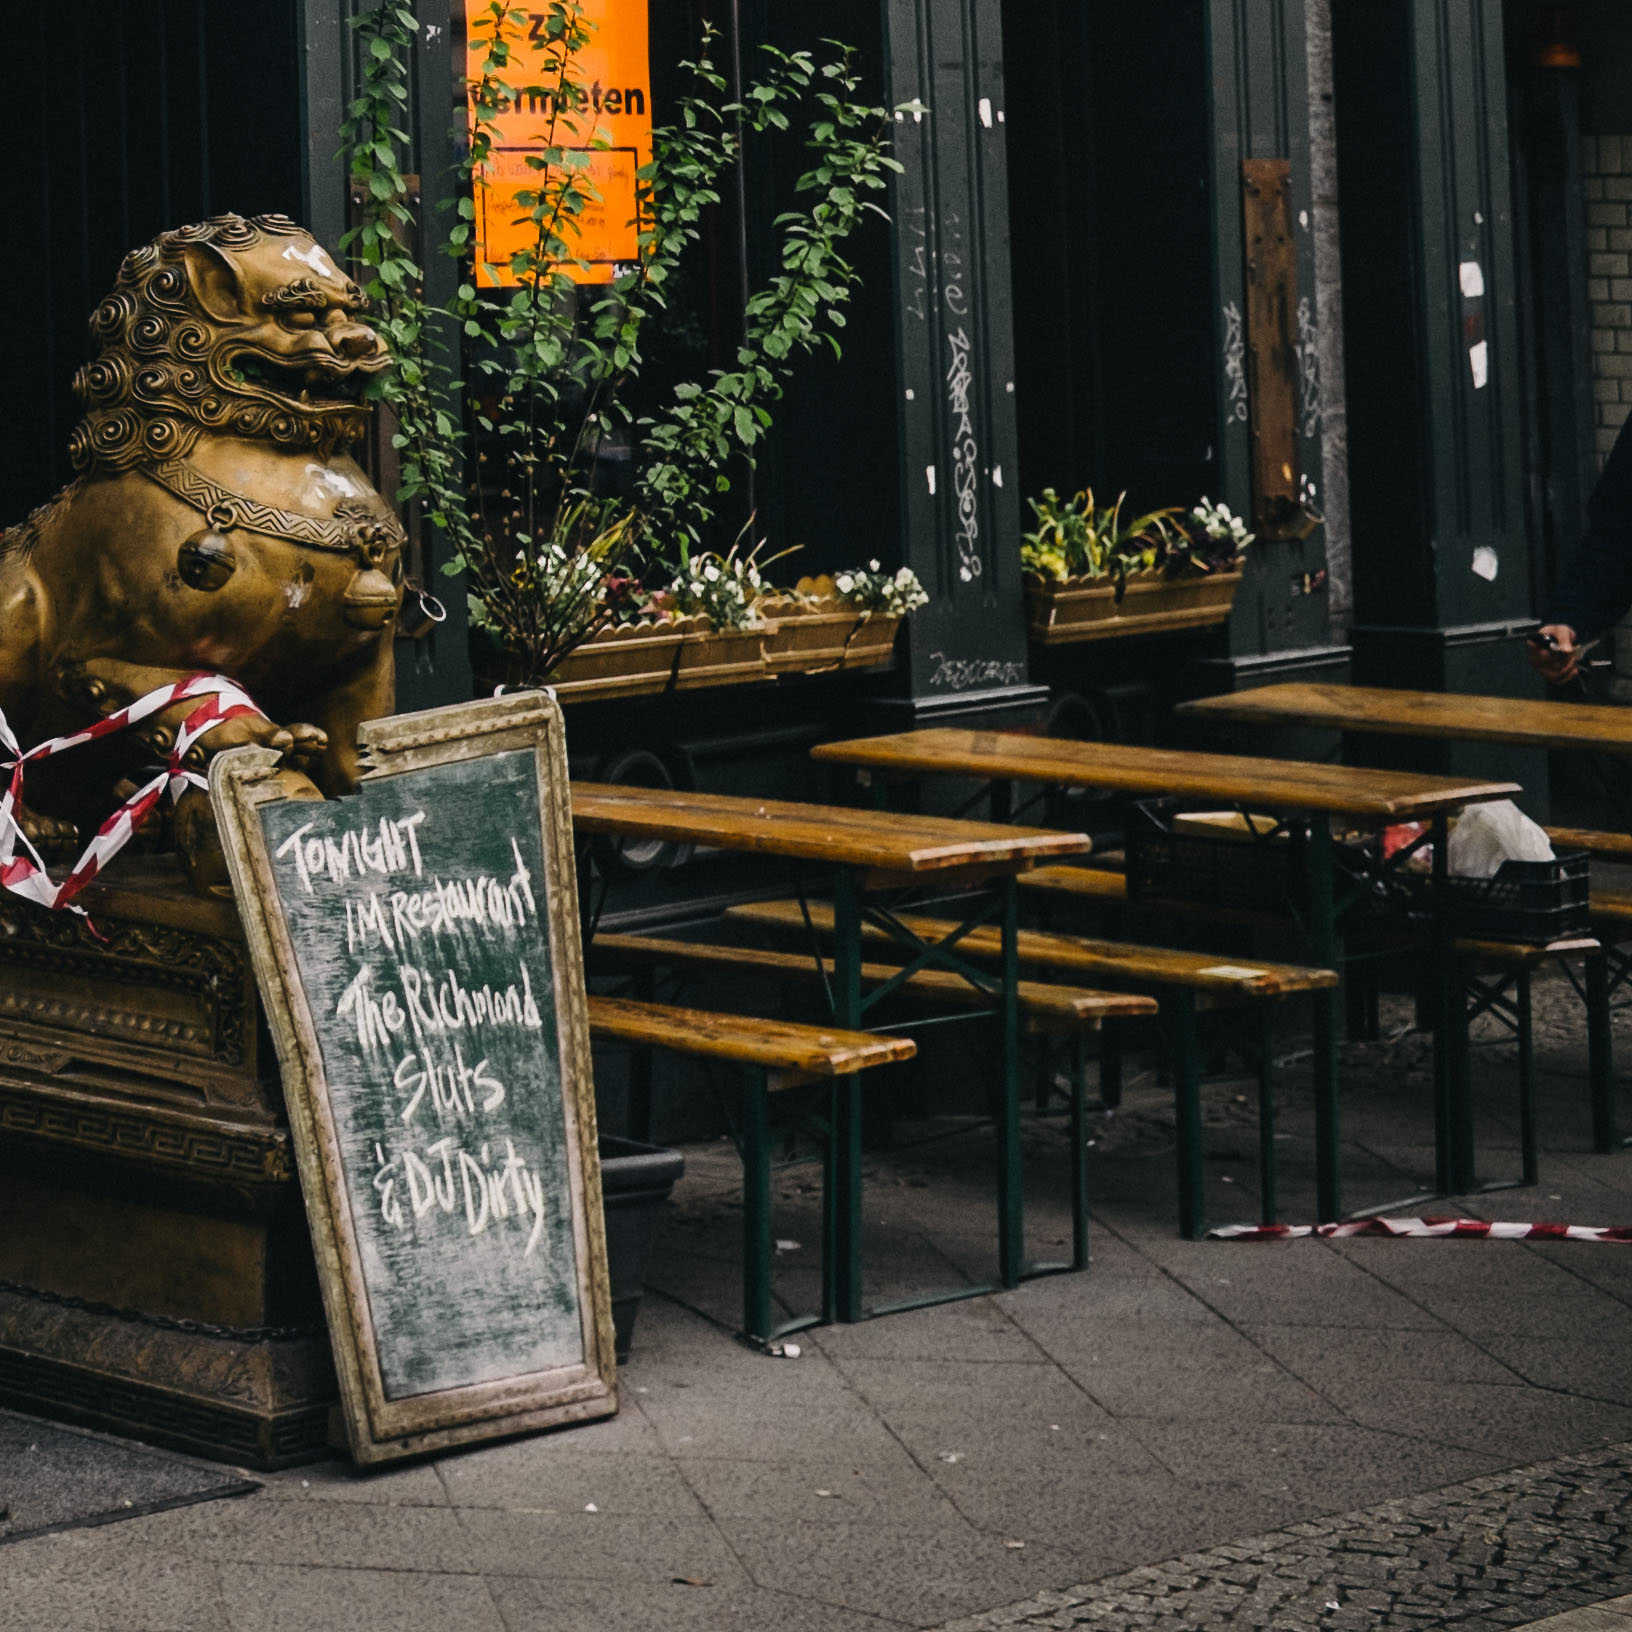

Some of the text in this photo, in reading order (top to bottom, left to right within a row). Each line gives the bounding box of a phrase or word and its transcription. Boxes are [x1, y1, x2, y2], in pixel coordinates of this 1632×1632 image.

[277, 809, 426, 894] TONIGHT
[346, 836, 537, 953] IM Restaurant
[336, 960, 542, 1052] The Richmond
[393, 1046, 506, 1122] Sluts
[403, 1136, 458, 1220] DJ
[458, 1139, 547, 1257] Dirty
